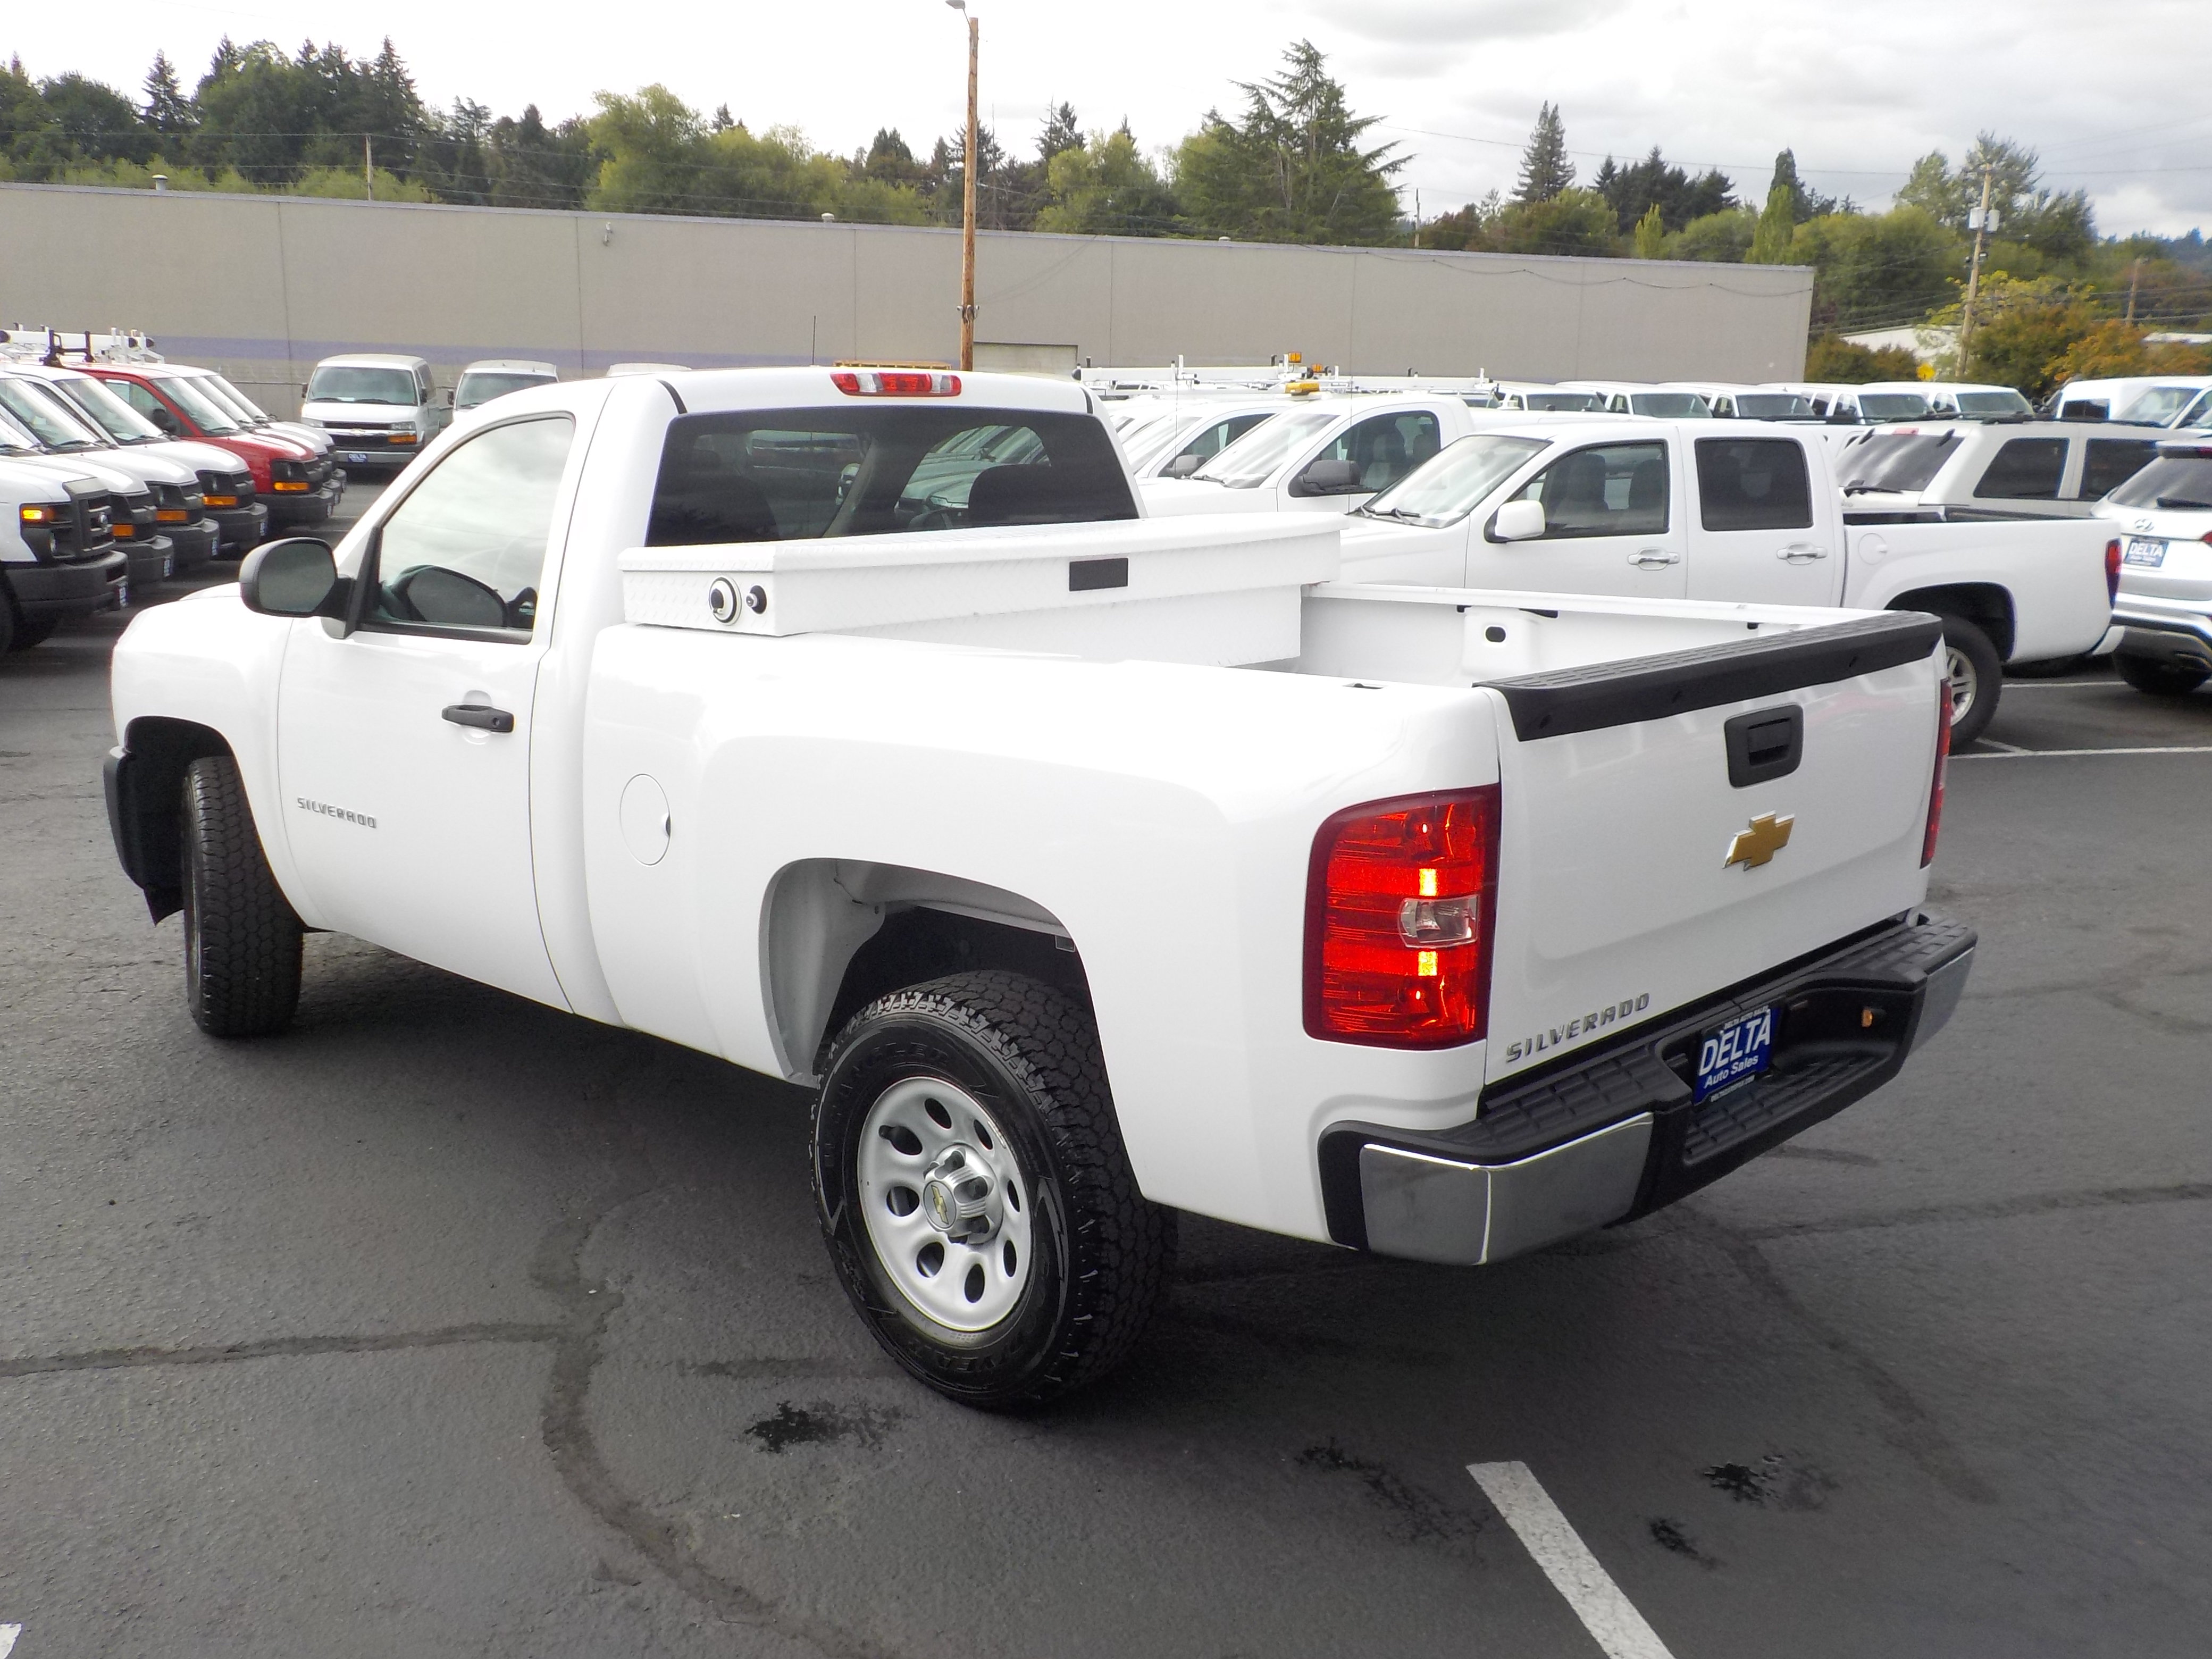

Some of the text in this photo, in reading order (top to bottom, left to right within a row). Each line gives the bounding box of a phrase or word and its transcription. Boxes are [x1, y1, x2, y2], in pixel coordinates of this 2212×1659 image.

[2129, 542, 2163, 557] DELTA
[297, 797, 377, 828] SILVERADO
[1506, 992, 1649, 1063] SILVERADO
[1698, 1010, 1771, 1076] DELTA
[1704, 1069, 1729, 1089] Auto
[1731, 1055, 1758, 1075] Sales
